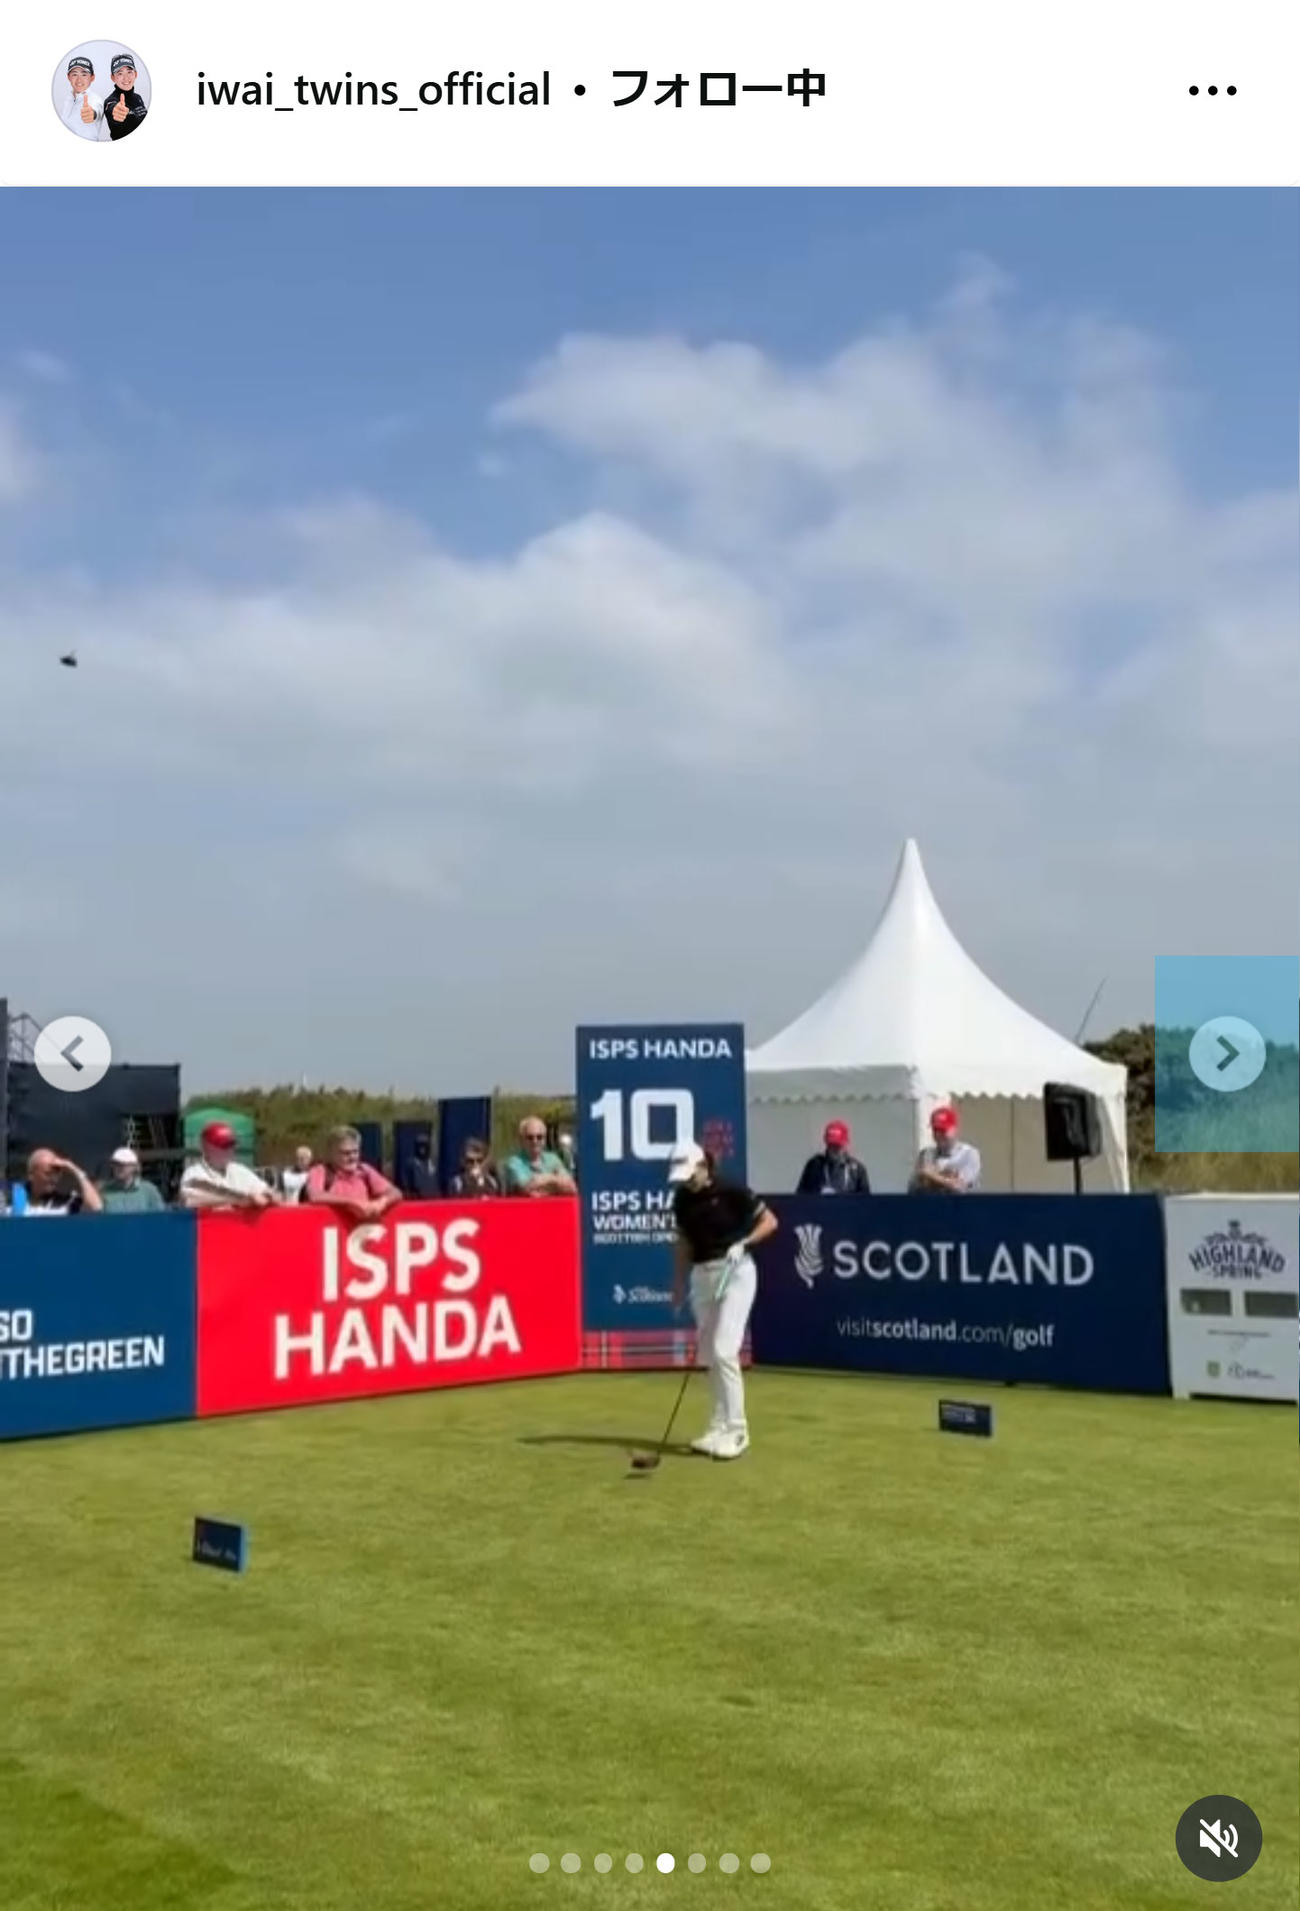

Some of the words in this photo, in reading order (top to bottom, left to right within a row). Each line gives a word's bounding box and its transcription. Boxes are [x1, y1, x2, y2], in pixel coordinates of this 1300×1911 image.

[590, 1040, 637, 1059] ISPS
[644, 1038, 733, 1059] HANDA
[590, 1088, 694, 1161] 10
[592, 1190, 640, 1211] ISPS
[321, 1217, 481, 1302] ISPS
[833, 1240, 1095, 1287] SCOTLAND
[1188, 1242, 1286, 1273] HIGHLAND
[273, 1296, 522, 1380] HANDA
[836, 1316, 1055, 1350] visitscotland.com/golf
[0, 1335, 165, 1380] THEGREEN
